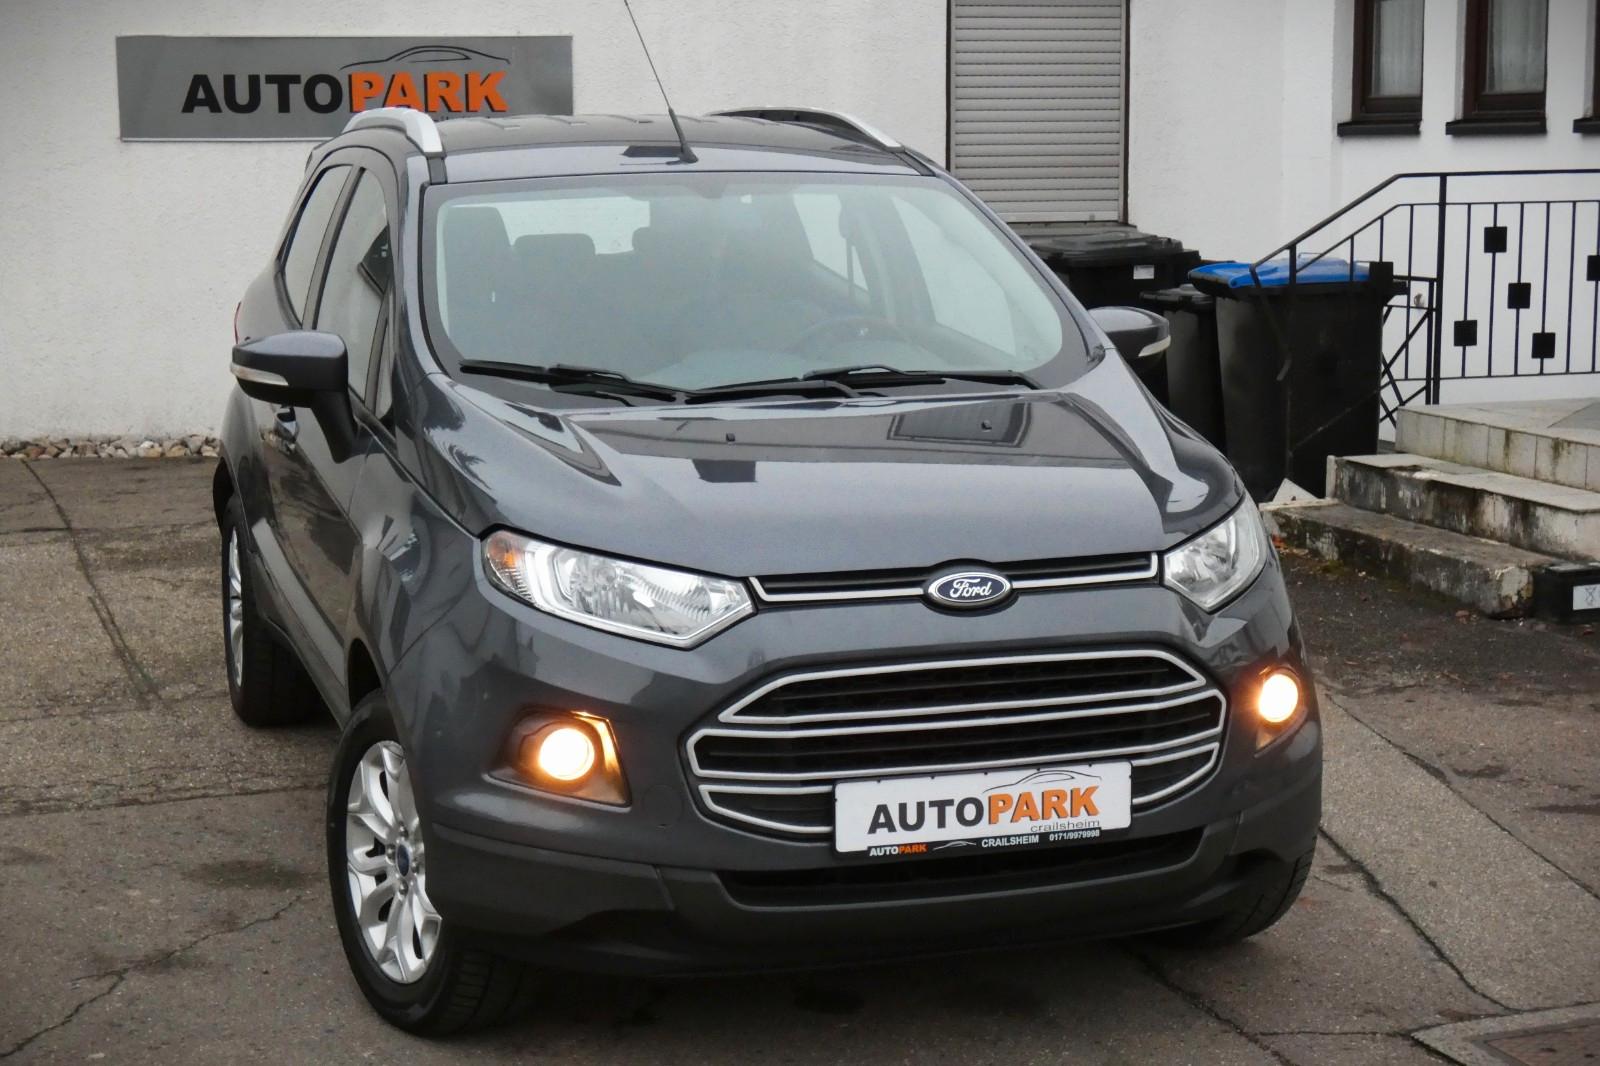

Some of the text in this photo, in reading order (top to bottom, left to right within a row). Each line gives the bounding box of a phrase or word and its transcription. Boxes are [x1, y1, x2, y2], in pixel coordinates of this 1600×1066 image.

[182, 71, 509, 113] AUTOPARK
[949, 578, 992, 598] Ford
[868, 785, 1100, 834] AUTOPARK
[1030, 819, 1100, 833] crailsheim
[869, 844, 927, 857] AUTOPARK
[981, 834, 1040, 848] CRAILSHEIM
